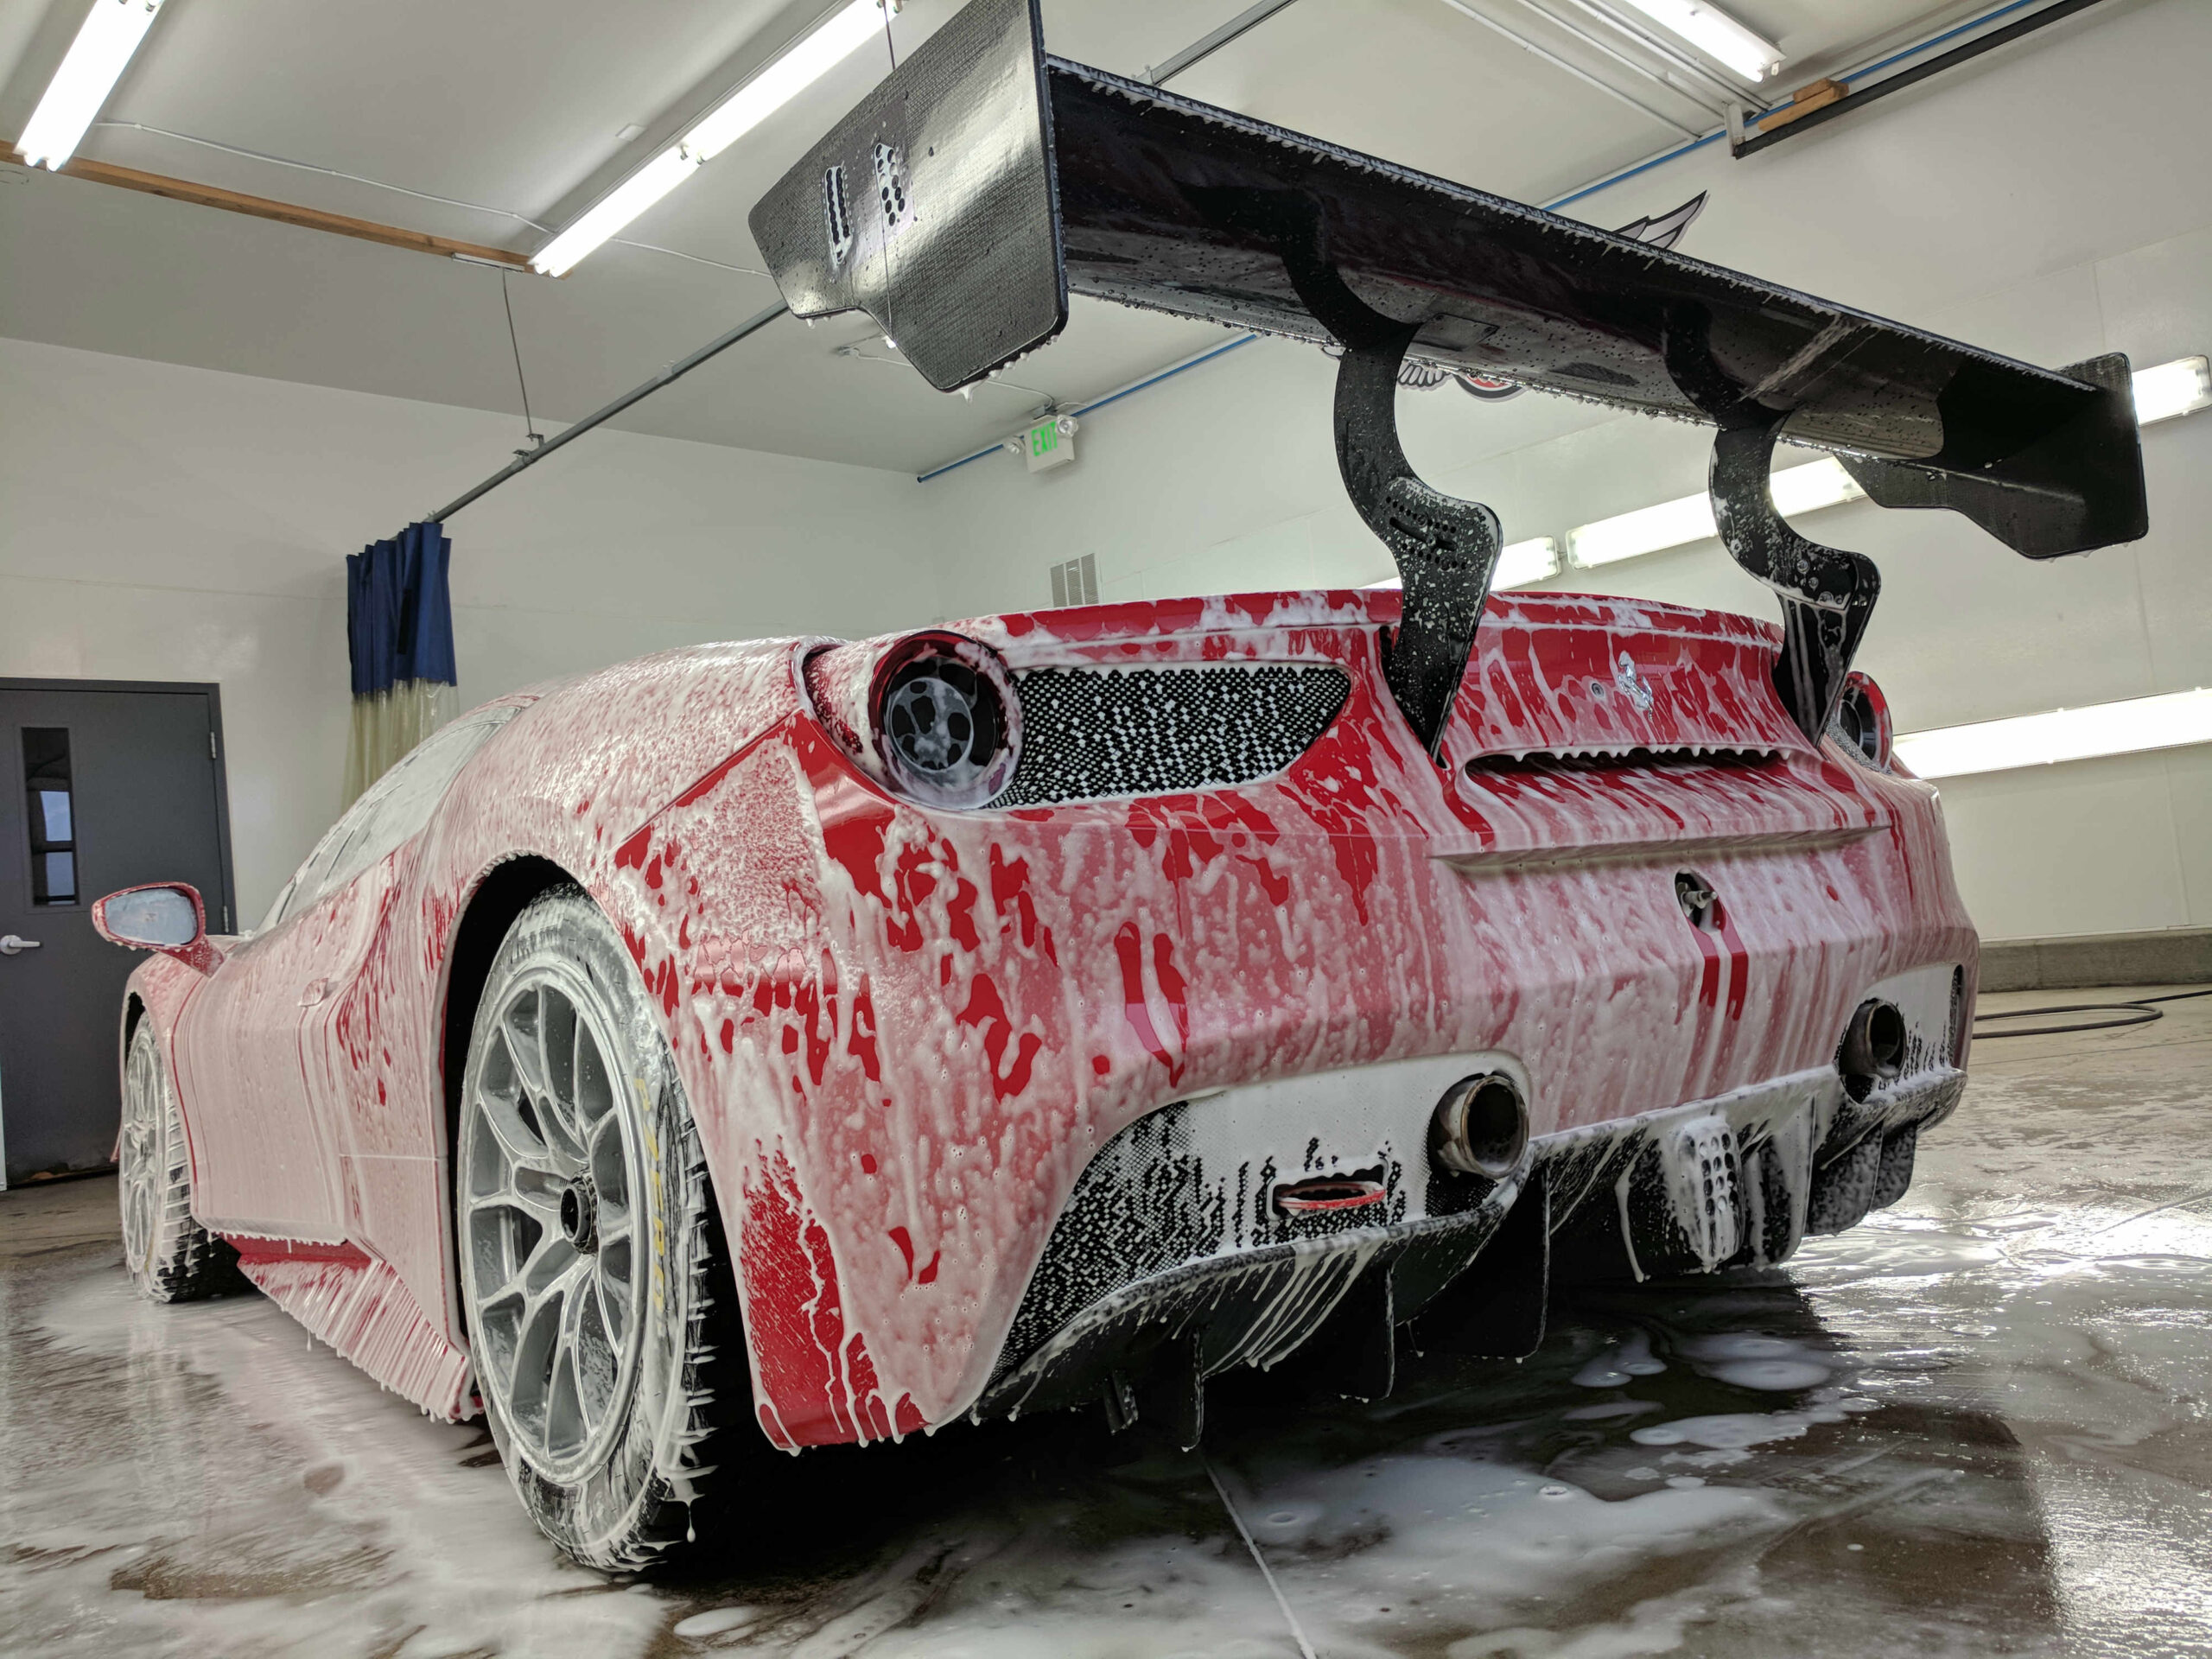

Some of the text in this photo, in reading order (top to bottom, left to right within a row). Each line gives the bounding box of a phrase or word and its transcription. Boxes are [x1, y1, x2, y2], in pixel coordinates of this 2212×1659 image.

[1031, 421, 1058, 457] EXIT
[634, 1078, 664, 1313] P ZERO
